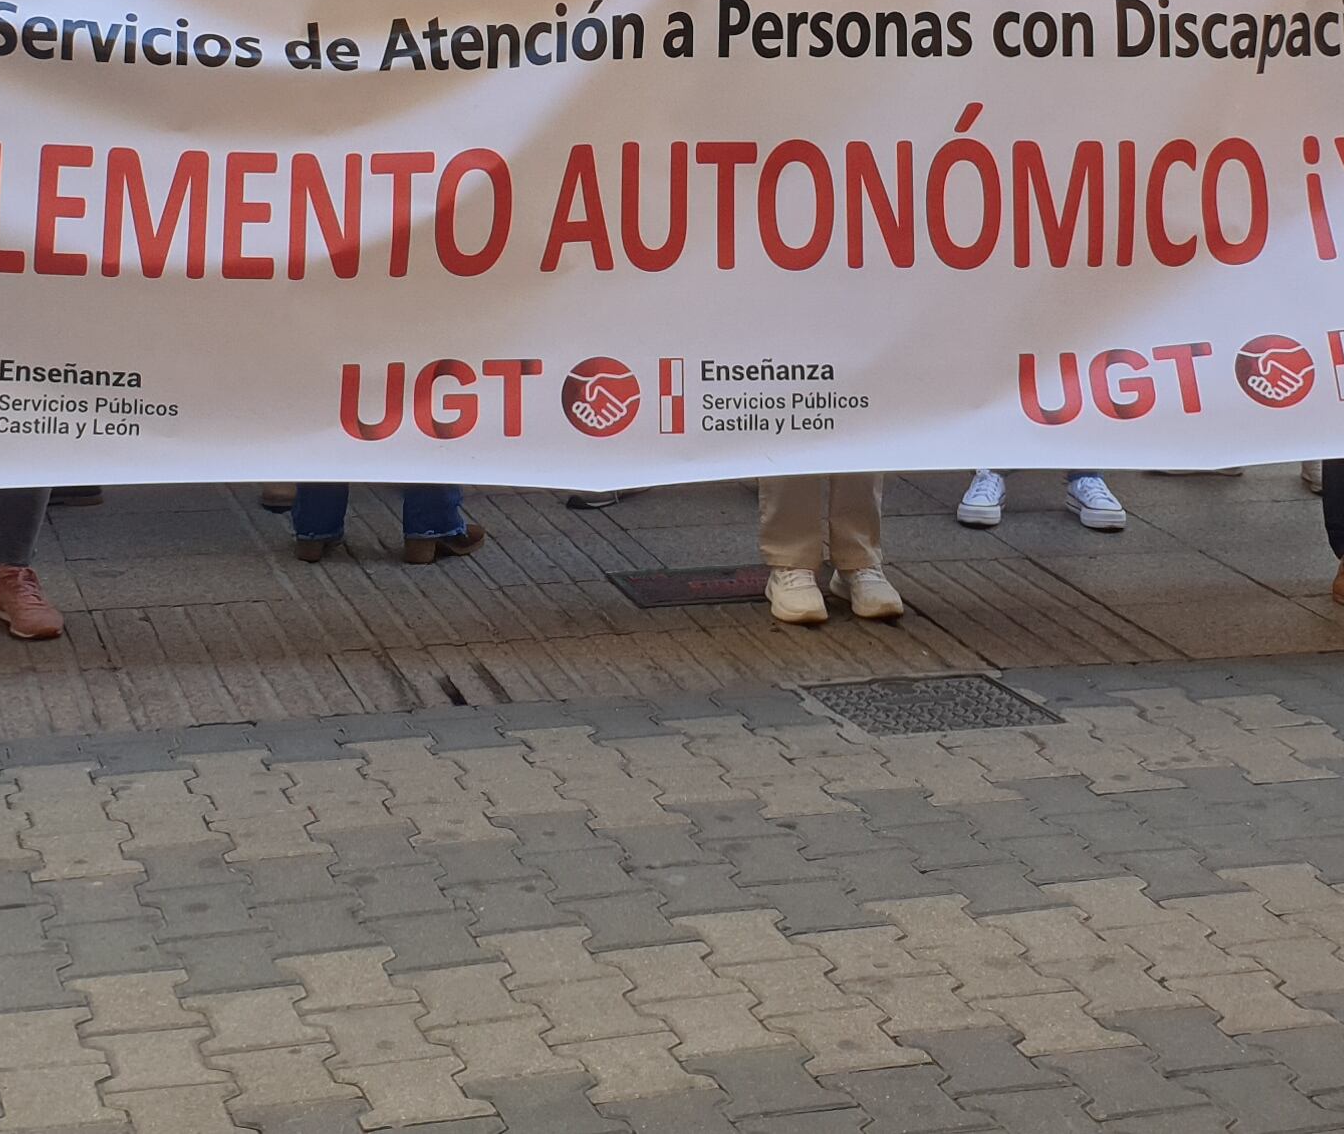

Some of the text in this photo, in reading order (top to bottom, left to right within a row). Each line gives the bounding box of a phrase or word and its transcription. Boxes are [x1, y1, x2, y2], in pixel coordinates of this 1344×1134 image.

[284, 22, 360, 72] de
[379, 0, 645, 72] Atención
[662, 10, 694, 58] a
[993, 10, 1094, 58] con
[540, 102, 1269, 272] AUTONÓMICO
[700, 357, 835, 382] Enseñanza
[1018, 341, 1213, 426] UGT
[94, 396, 179, 417] Públicos
[339, 358, 543, 442] UGT
[702, 390, 869, 410] Servicios Públicos
[74, 422, 86, 439] y
[92, 416, 141, 437] León
[701, 412, 835, 435] Castilla y León
